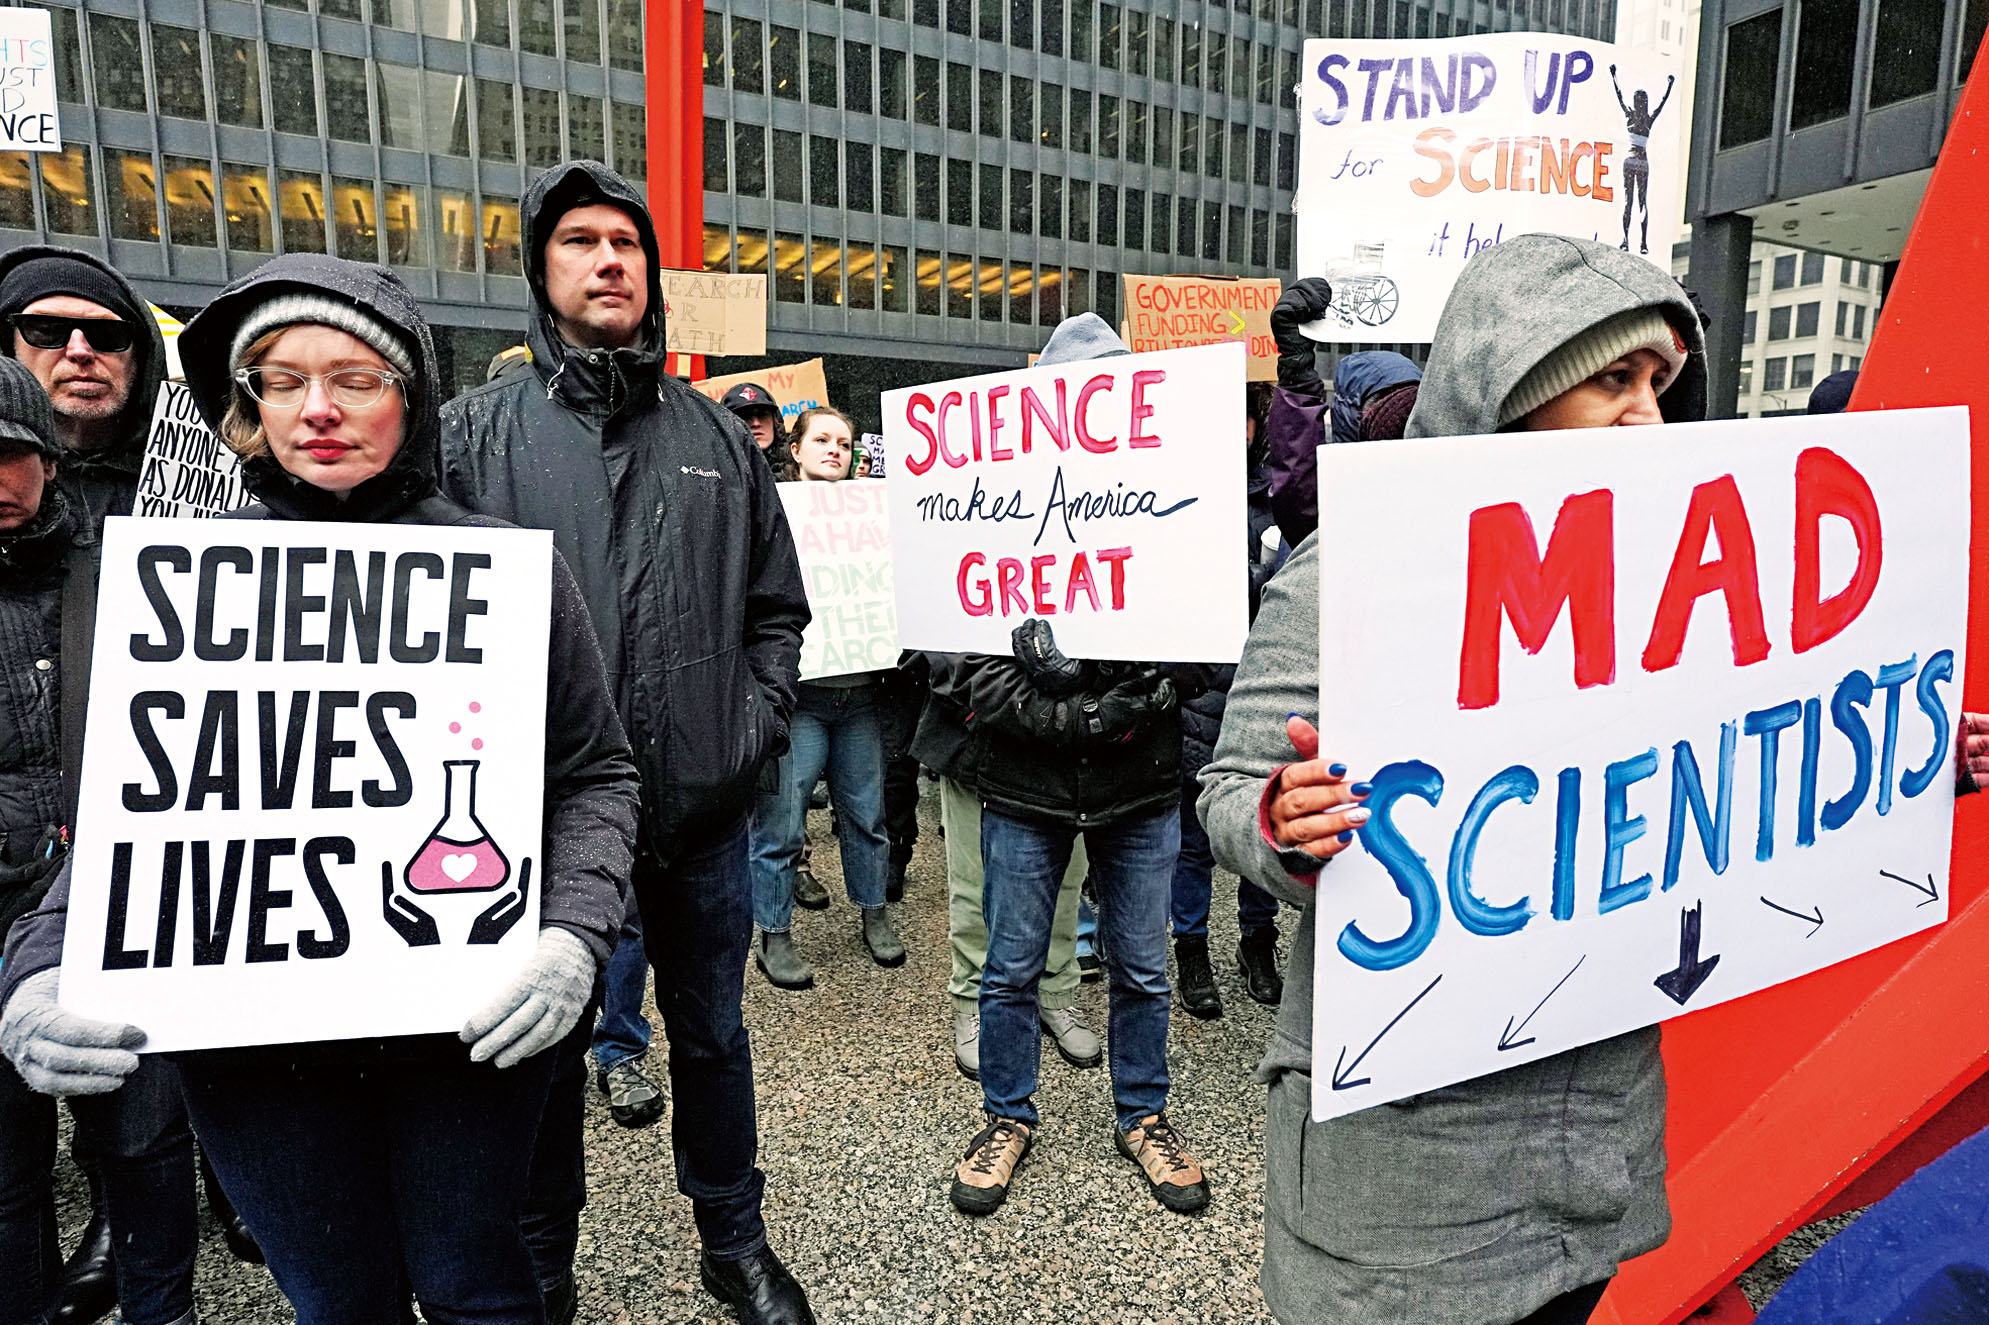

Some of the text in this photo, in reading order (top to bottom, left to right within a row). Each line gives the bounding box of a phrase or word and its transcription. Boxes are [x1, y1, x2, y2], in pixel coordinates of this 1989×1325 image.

[1312, 49, 1595, 127] STAND UP
[1329, 126, 1614, 203] for SCIENCE
[1427, 221, 1450, 258] it
[1136, 283, 1280, 312] GOVERNMENT
[1137, 313, 1227, 337] FUNDING
[148, 419, 225, 473] ANYONE
[905, 370, 1167, 476] SCIENCE
[138, 457, 169, 498] AS
[809, 484, 887, 518] JUST
[917, 465, 1199, 547] makes America
[130, 545, 492, 664] SCIENCE
[956, 545, 1134, 618] GREAT
[1457, 446, 1883, 711] MAD
[122, 690, 417, 812] SAVES
[1337, 649, 1955, 971] SCIENTISTS
[102, 836, 356, 971] LIVES
